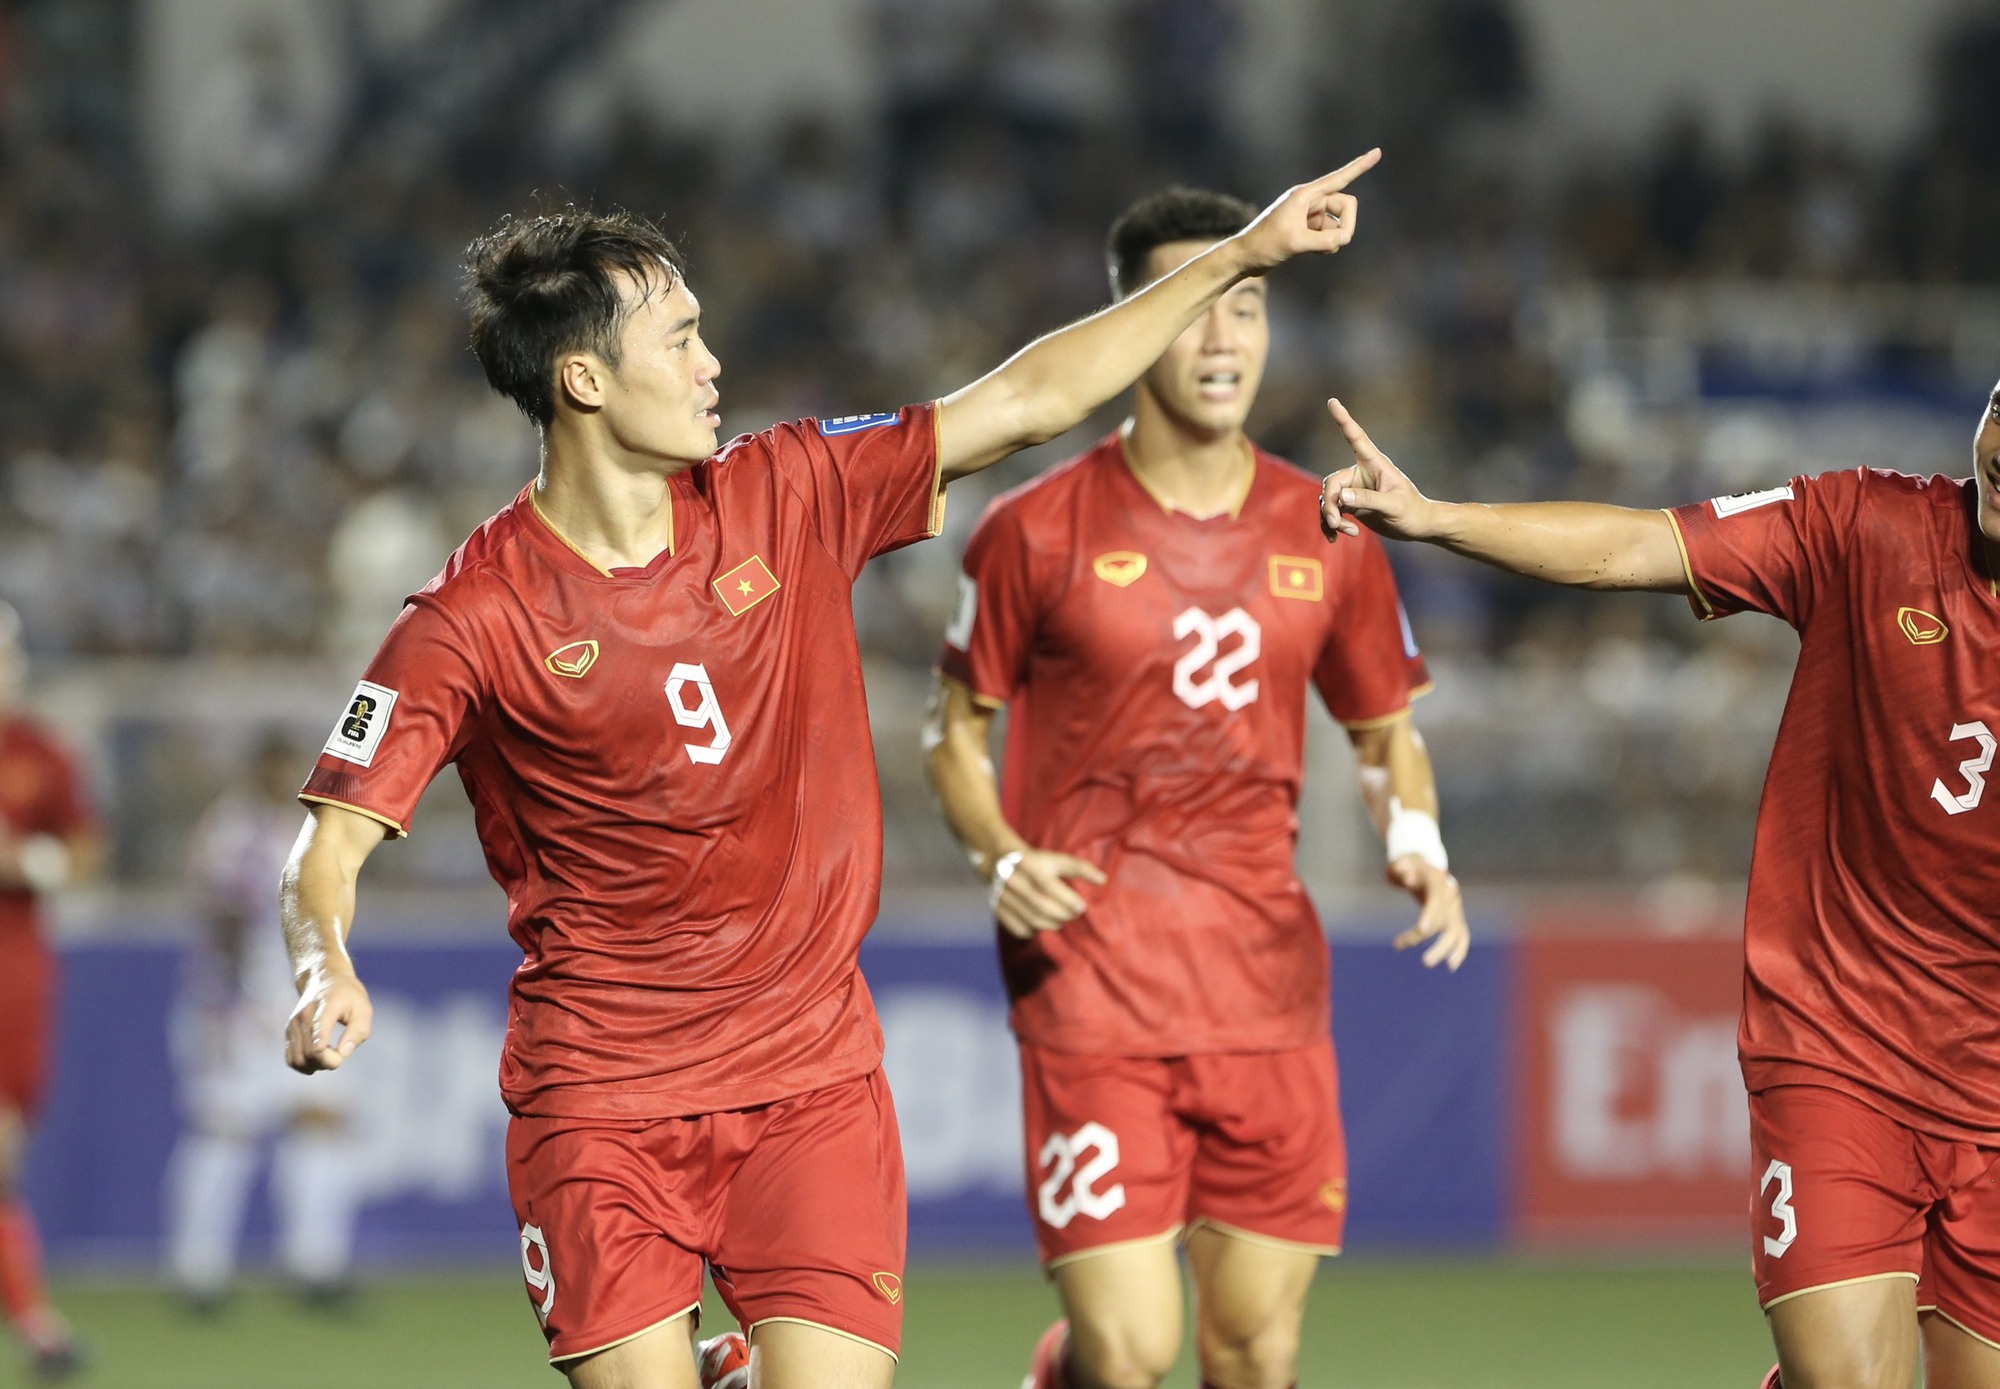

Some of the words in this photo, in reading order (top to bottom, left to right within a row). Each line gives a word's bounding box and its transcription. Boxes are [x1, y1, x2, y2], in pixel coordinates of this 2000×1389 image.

[1172, 605, 1262, 712] 22
[663, 661, 733, 766] 9
[1930, 720, 1998, 816] 3
[1038, 1121, 1126, 1229] 22
[1760, 1158, 1798, 1259] 3
[520, 1221, 556, 1328] 9
